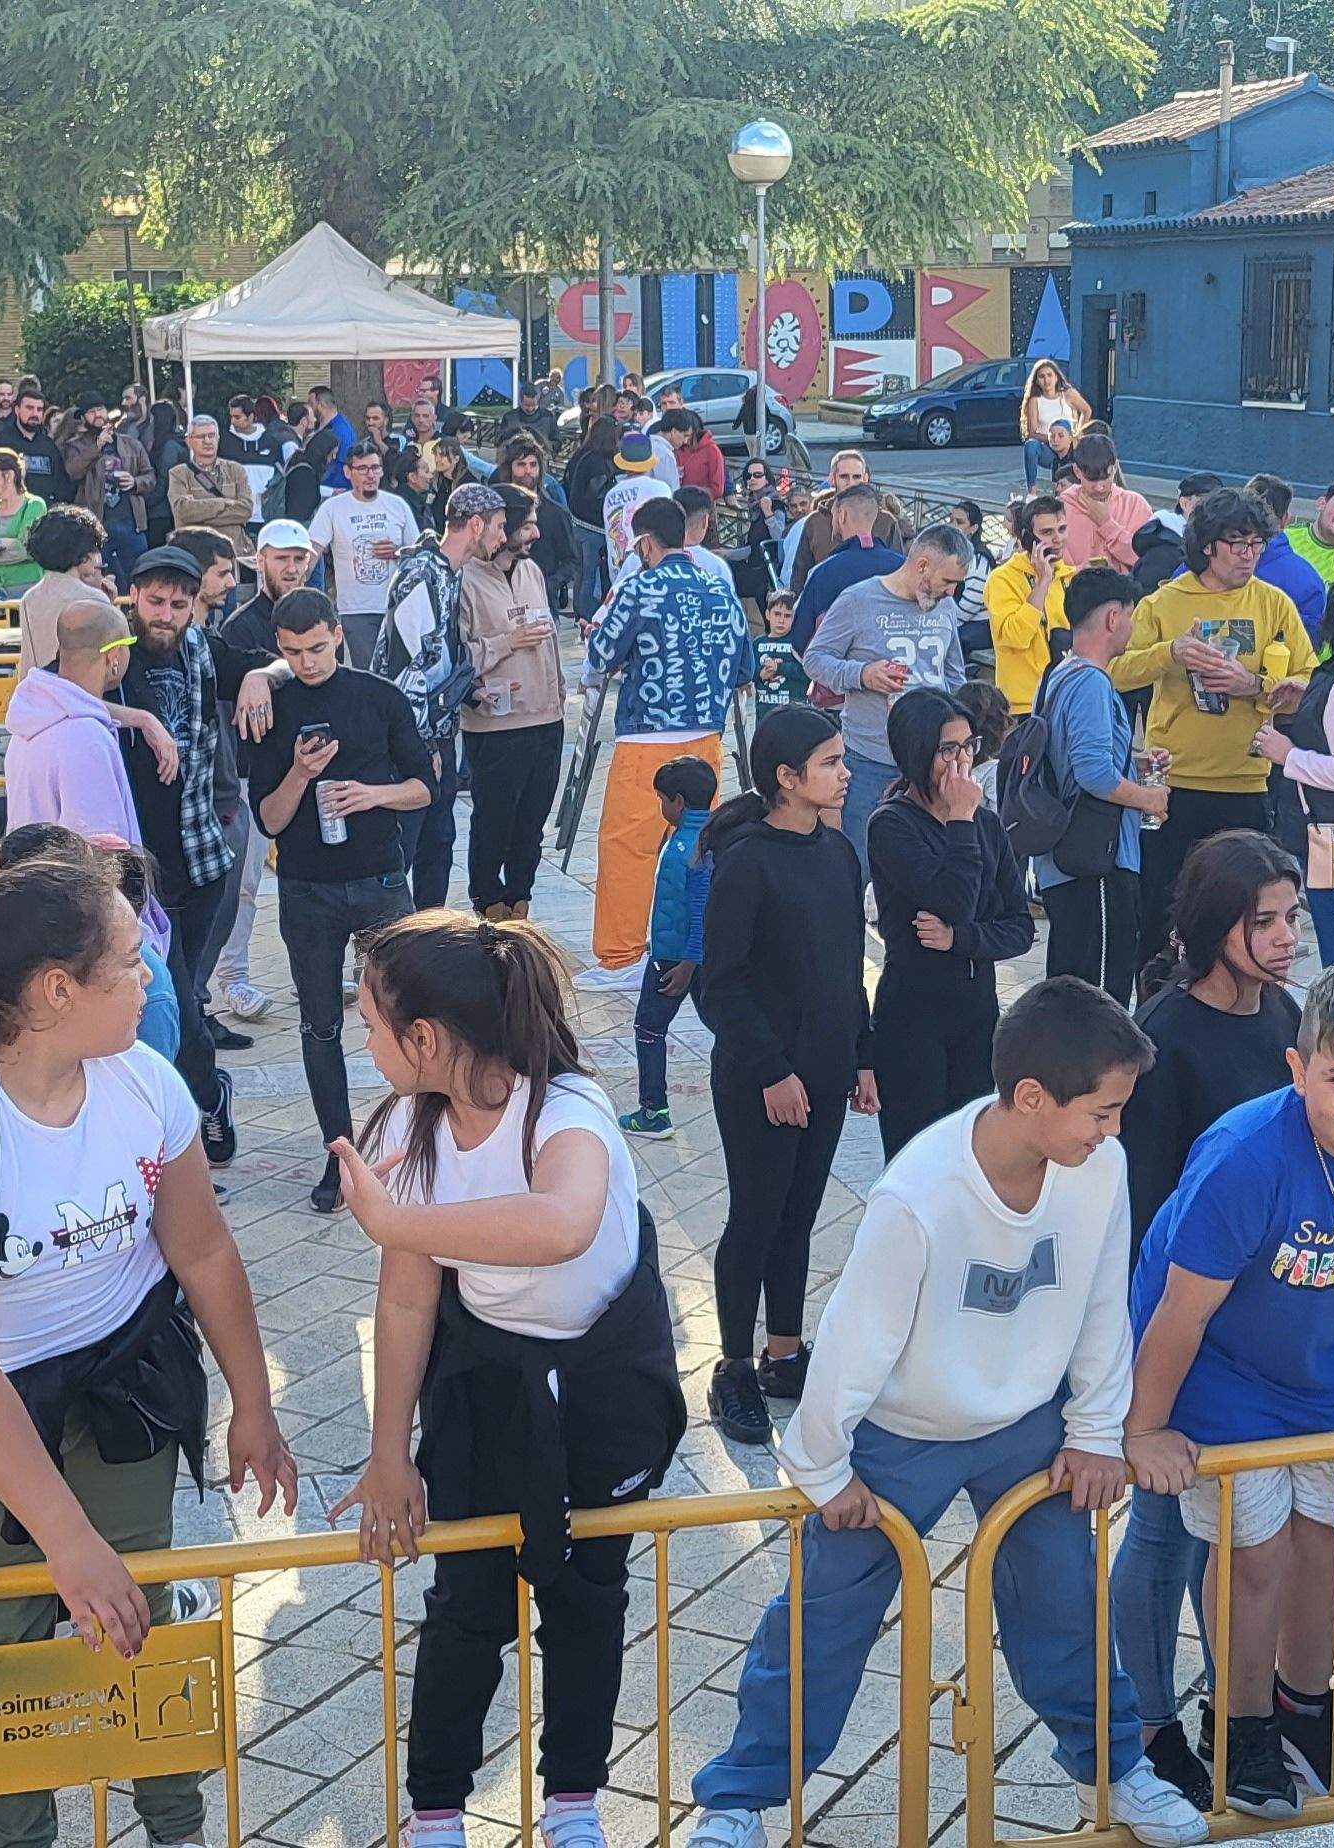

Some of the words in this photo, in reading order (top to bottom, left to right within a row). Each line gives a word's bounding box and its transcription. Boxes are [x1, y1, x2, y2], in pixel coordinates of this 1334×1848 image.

[639, 564, 691, 584] CALL
[638, 583, 668, 619] ME
[758, 642, 792, 653] SUPER
[665, 613, 687, 726] MORNING
[69, 1214, 130, 1244] ORIGINAL
